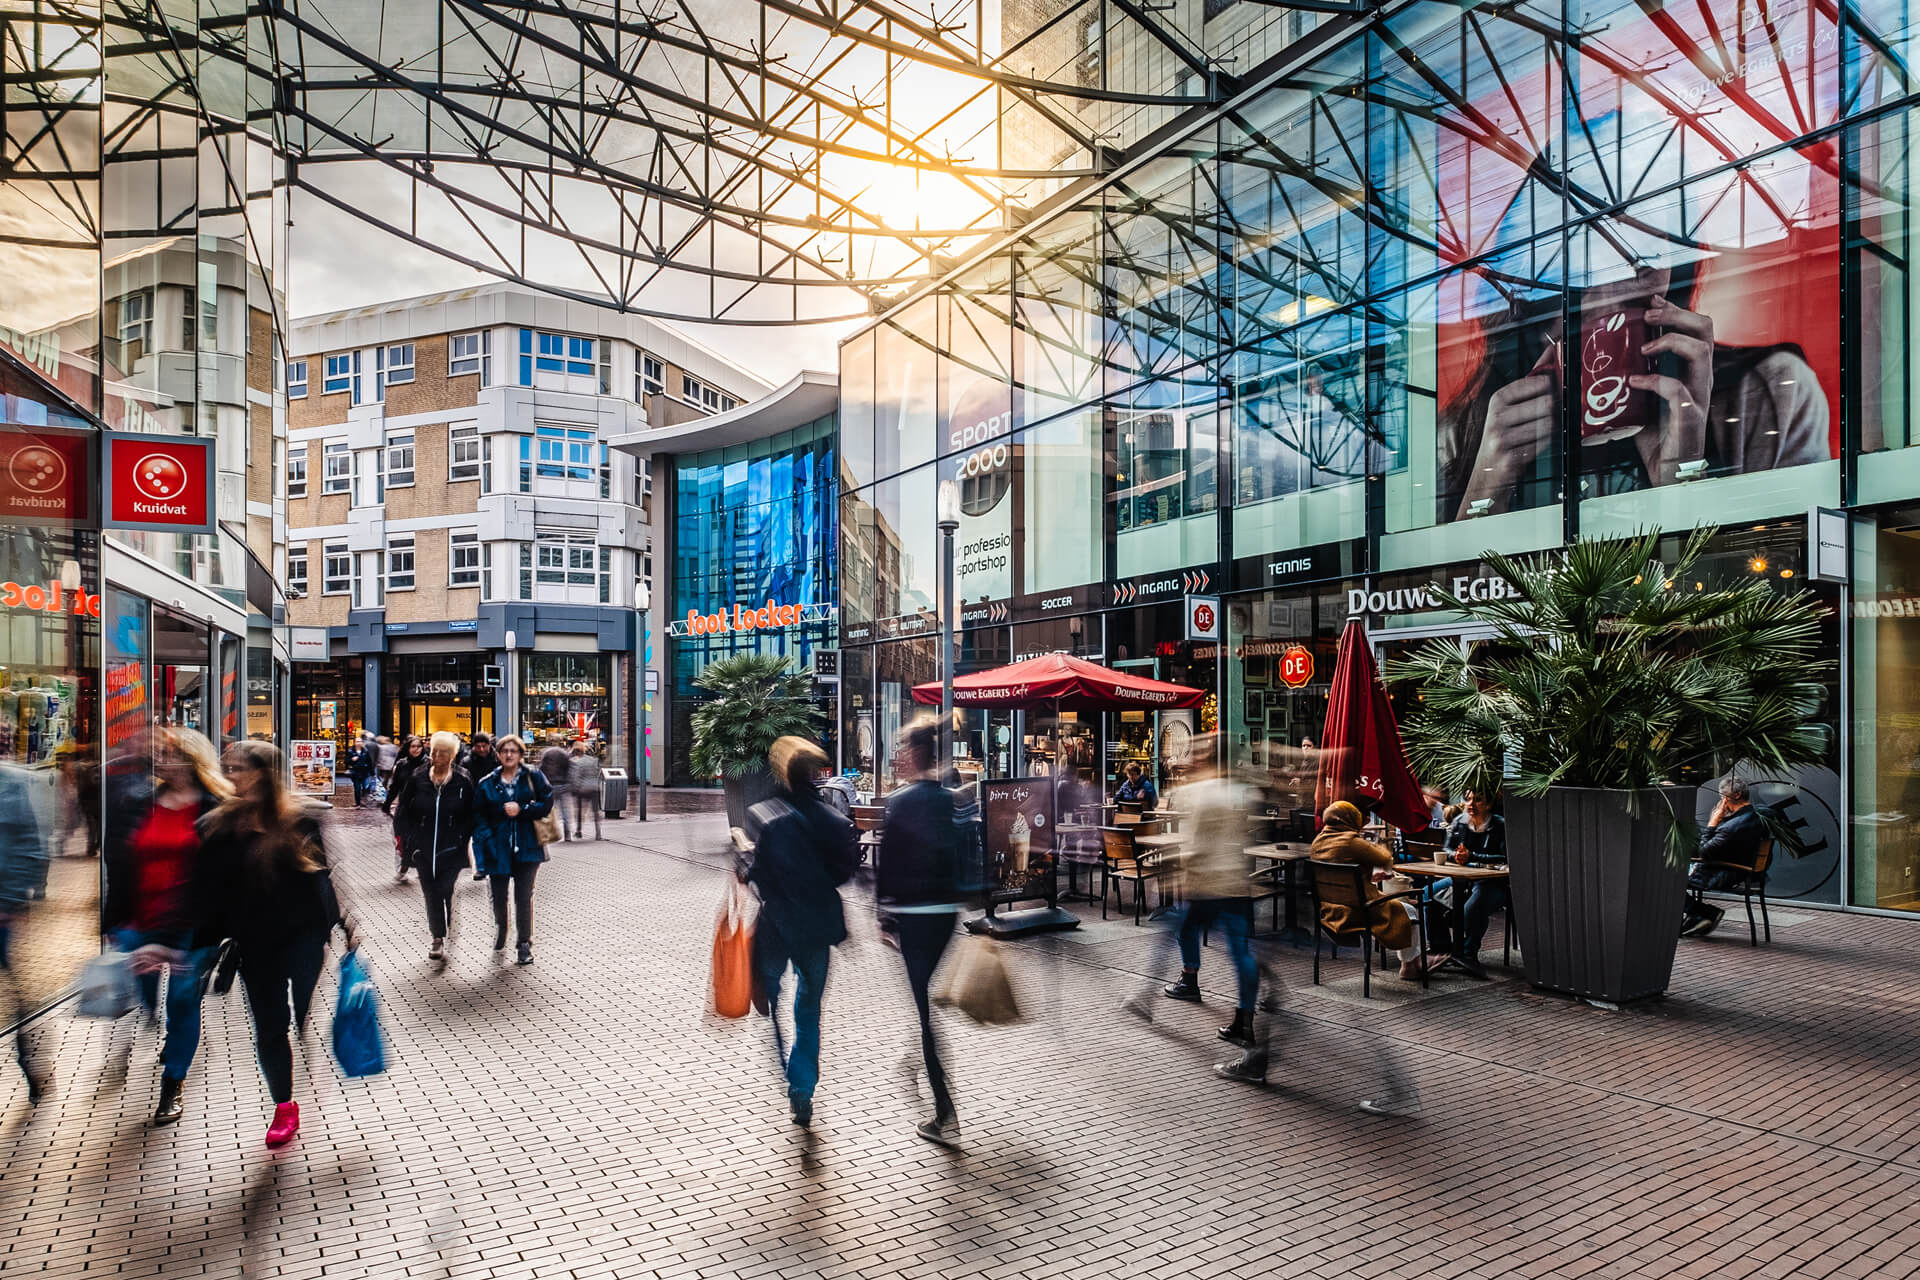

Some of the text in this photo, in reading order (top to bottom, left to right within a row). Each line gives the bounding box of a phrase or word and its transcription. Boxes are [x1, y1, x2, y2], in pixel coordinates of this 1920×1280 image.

[951, 410, 1011, 453] SPORT
[955, 443, 1007, 481] 2000
[133, 502, 187, 515] Kruidvat
[957, 555, 1007, 580] sportshop
[1268, 558, 1312, 576] TENNIS
[1139, 579, 1179, 595] INGANG
[1041, 596, 1072, 610] SOCCER
[687, 598, 803, 637] Foot Locker
[537, 681, 594, 693] NELSON
[978, 687, 1010, 699] EGBERTS
